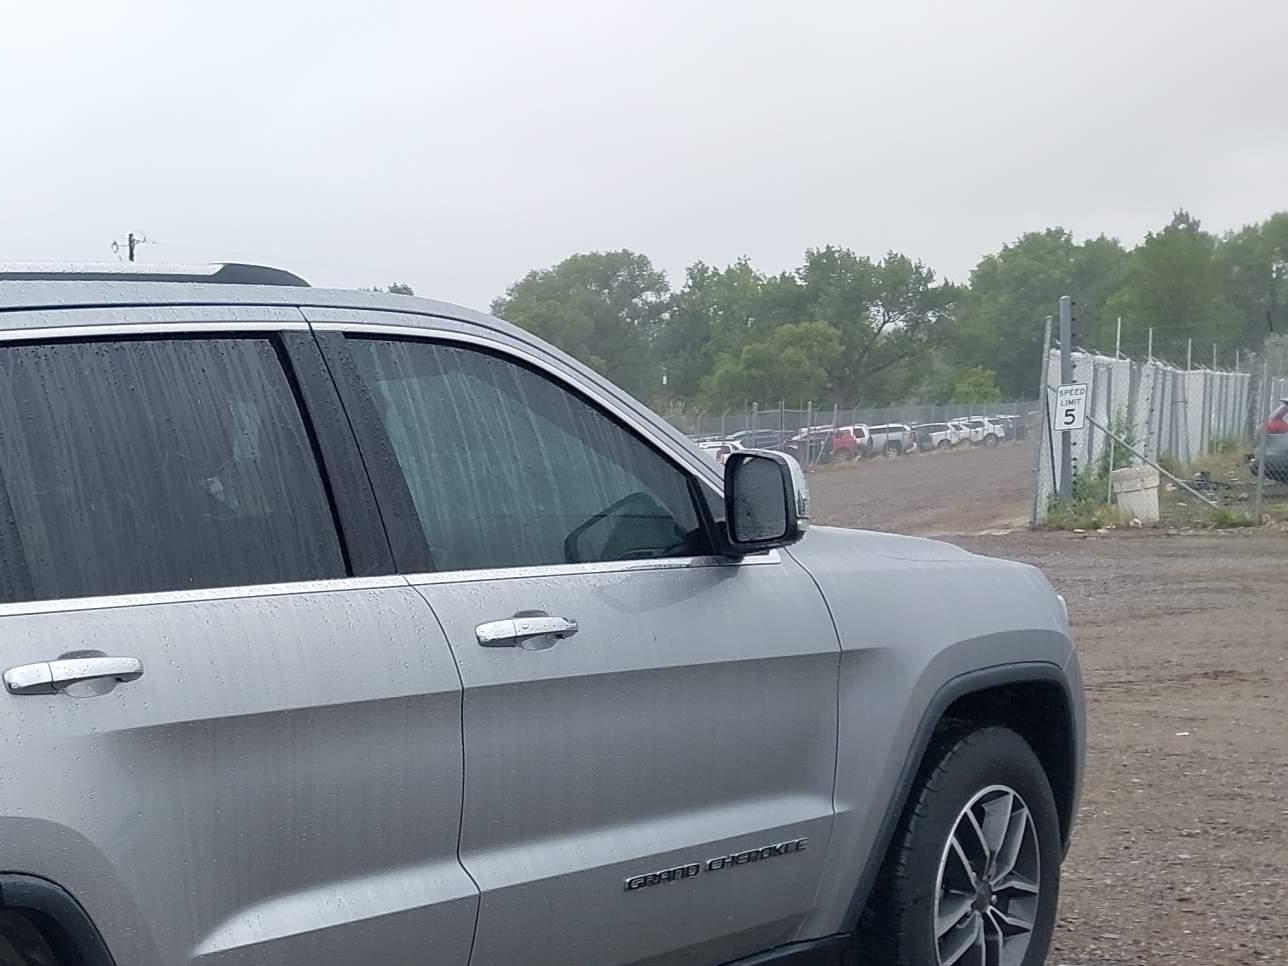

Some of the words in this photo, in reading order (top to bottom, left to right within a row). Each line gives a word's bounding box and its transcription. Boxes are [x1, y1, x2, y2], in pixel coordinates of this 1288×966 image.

[1059, 388, 1085, 396] SPEED
[1060, 398, 1081, 406] LIMIT
[1063, 408, 1075, 425] 5
[624, 862, 700, 891] GRAND
[705, 838, 808, 872] CHEROKEE
